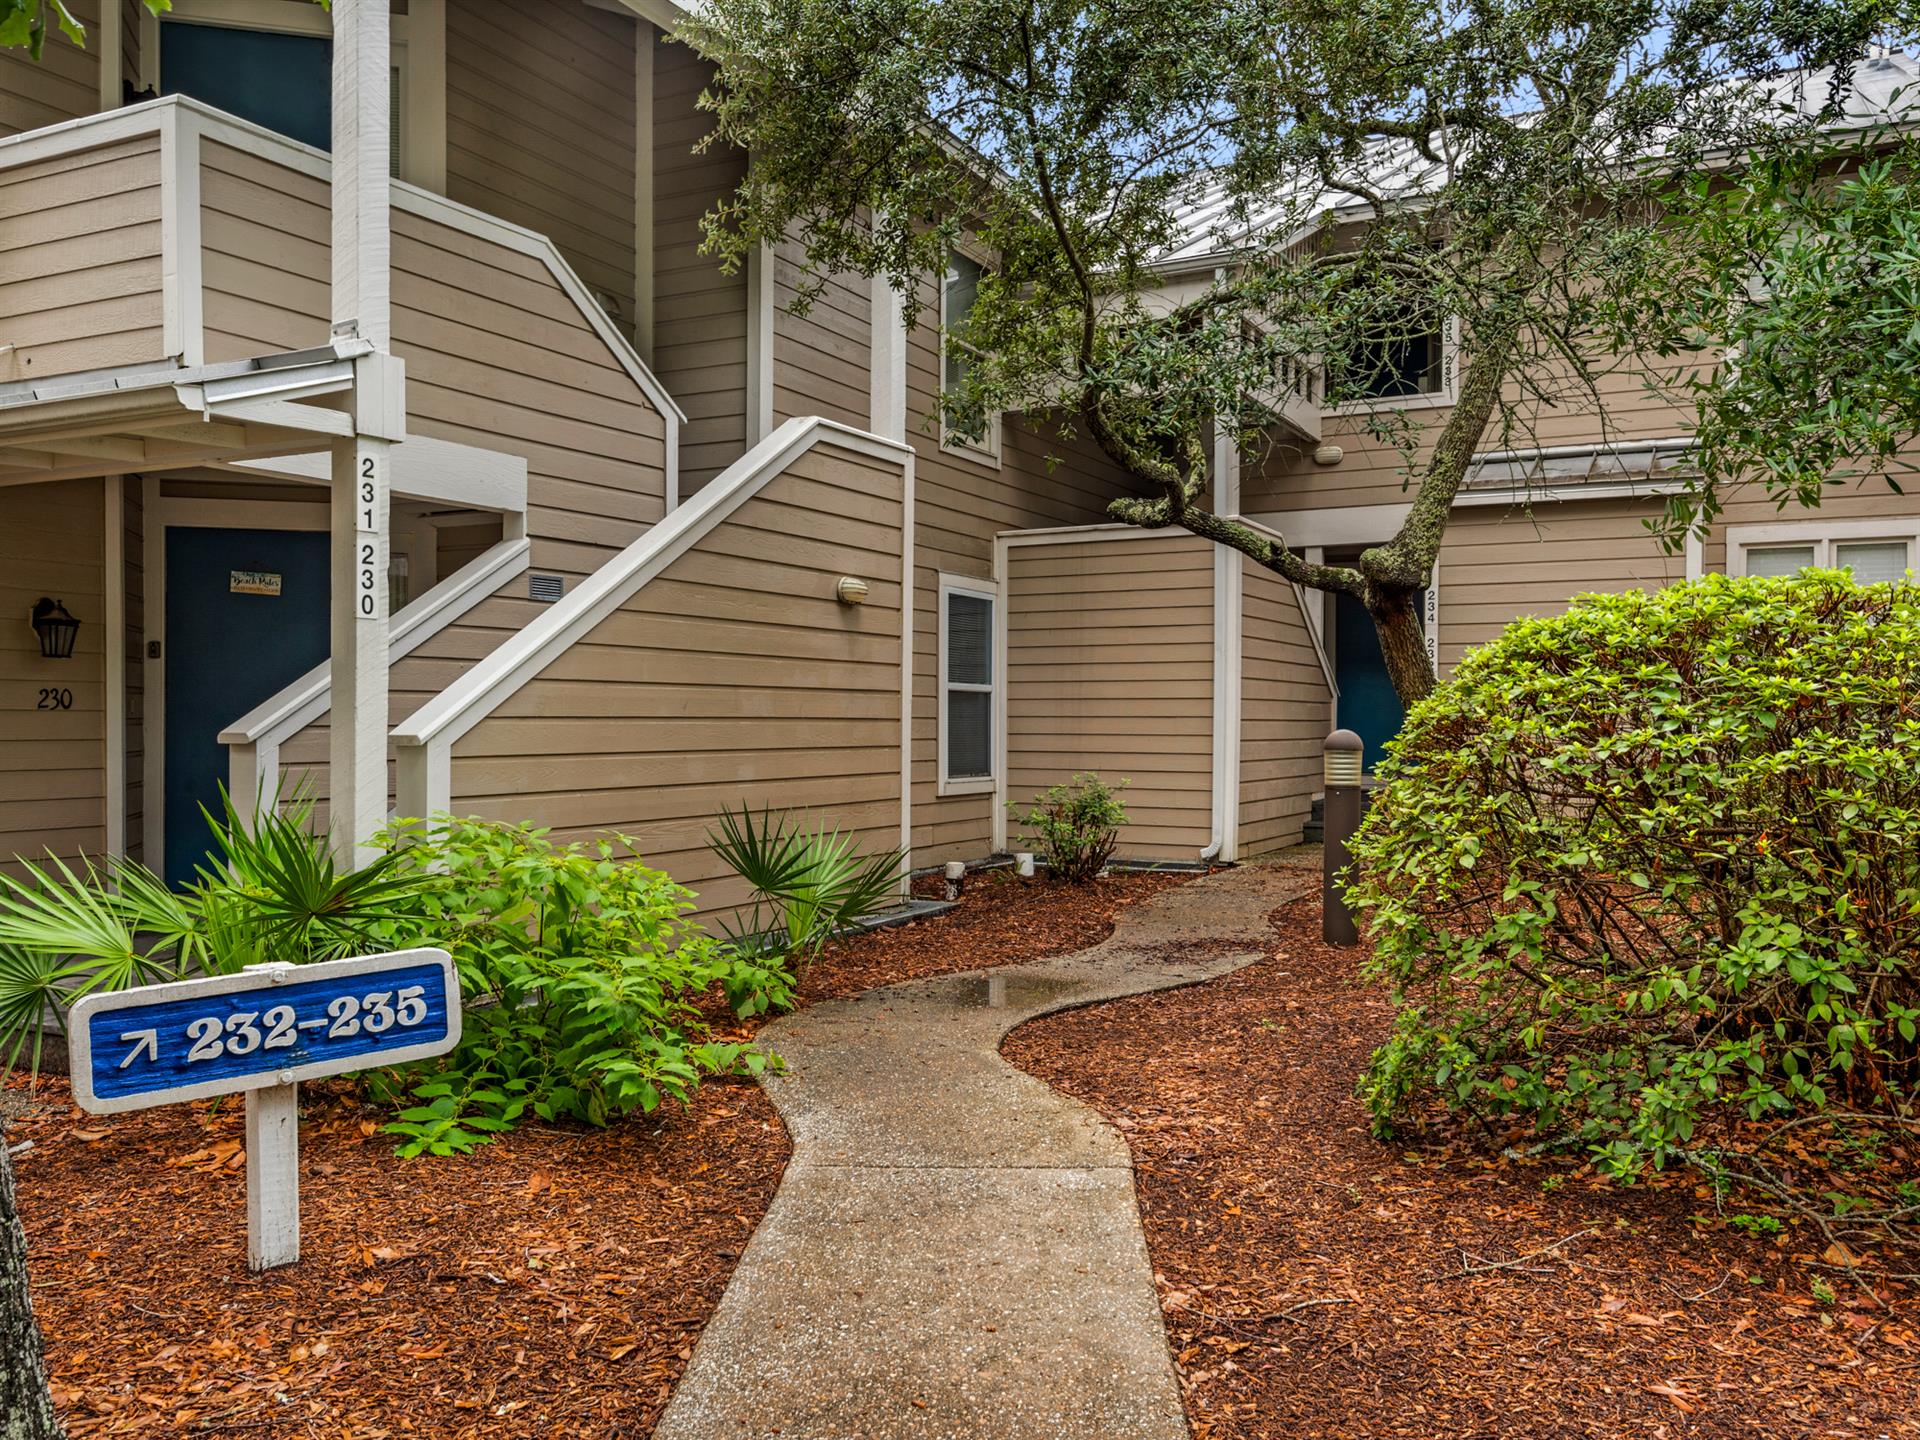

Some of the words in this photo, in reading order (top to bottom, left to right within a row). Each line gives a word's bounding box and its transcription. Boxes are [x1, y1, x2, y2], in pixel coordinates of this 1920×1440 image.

[361, 457, 375, 529] 231
[231, 575, 257, 586] Beach
[361, 544, 374, 615] 230
[1427, 590, 1435, 623] 234
[38, 687, 73, 711] 230
[186, 985, 428, 1063] 232-235
